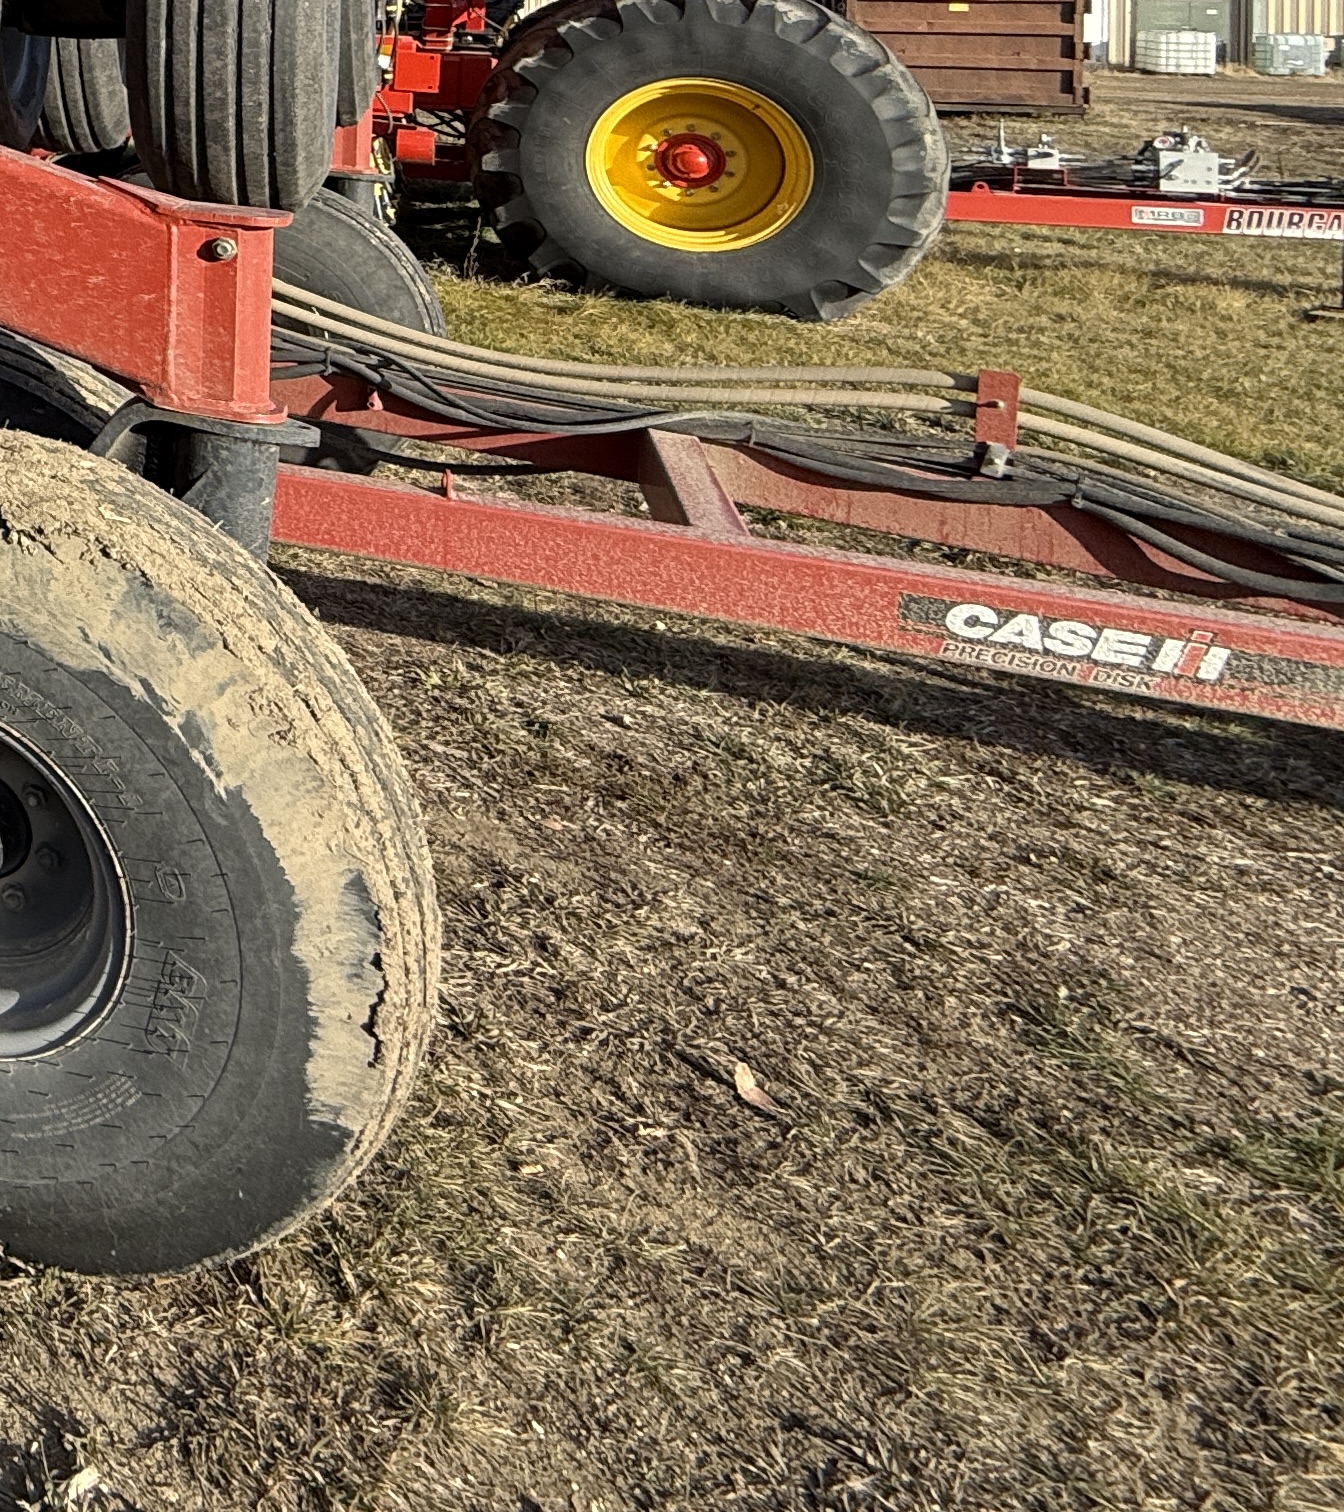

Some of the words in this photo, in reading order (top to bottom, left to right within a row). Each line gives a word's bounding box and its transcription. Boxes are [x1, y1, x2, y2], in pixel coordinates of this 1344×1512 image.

[1224, 207, 1344, 236] BOURGA
[945, 603, 1154, 668] CASE
[940, 641, 1078, 679] PRECISION
[1092, 668, 1164, 691] DISK
